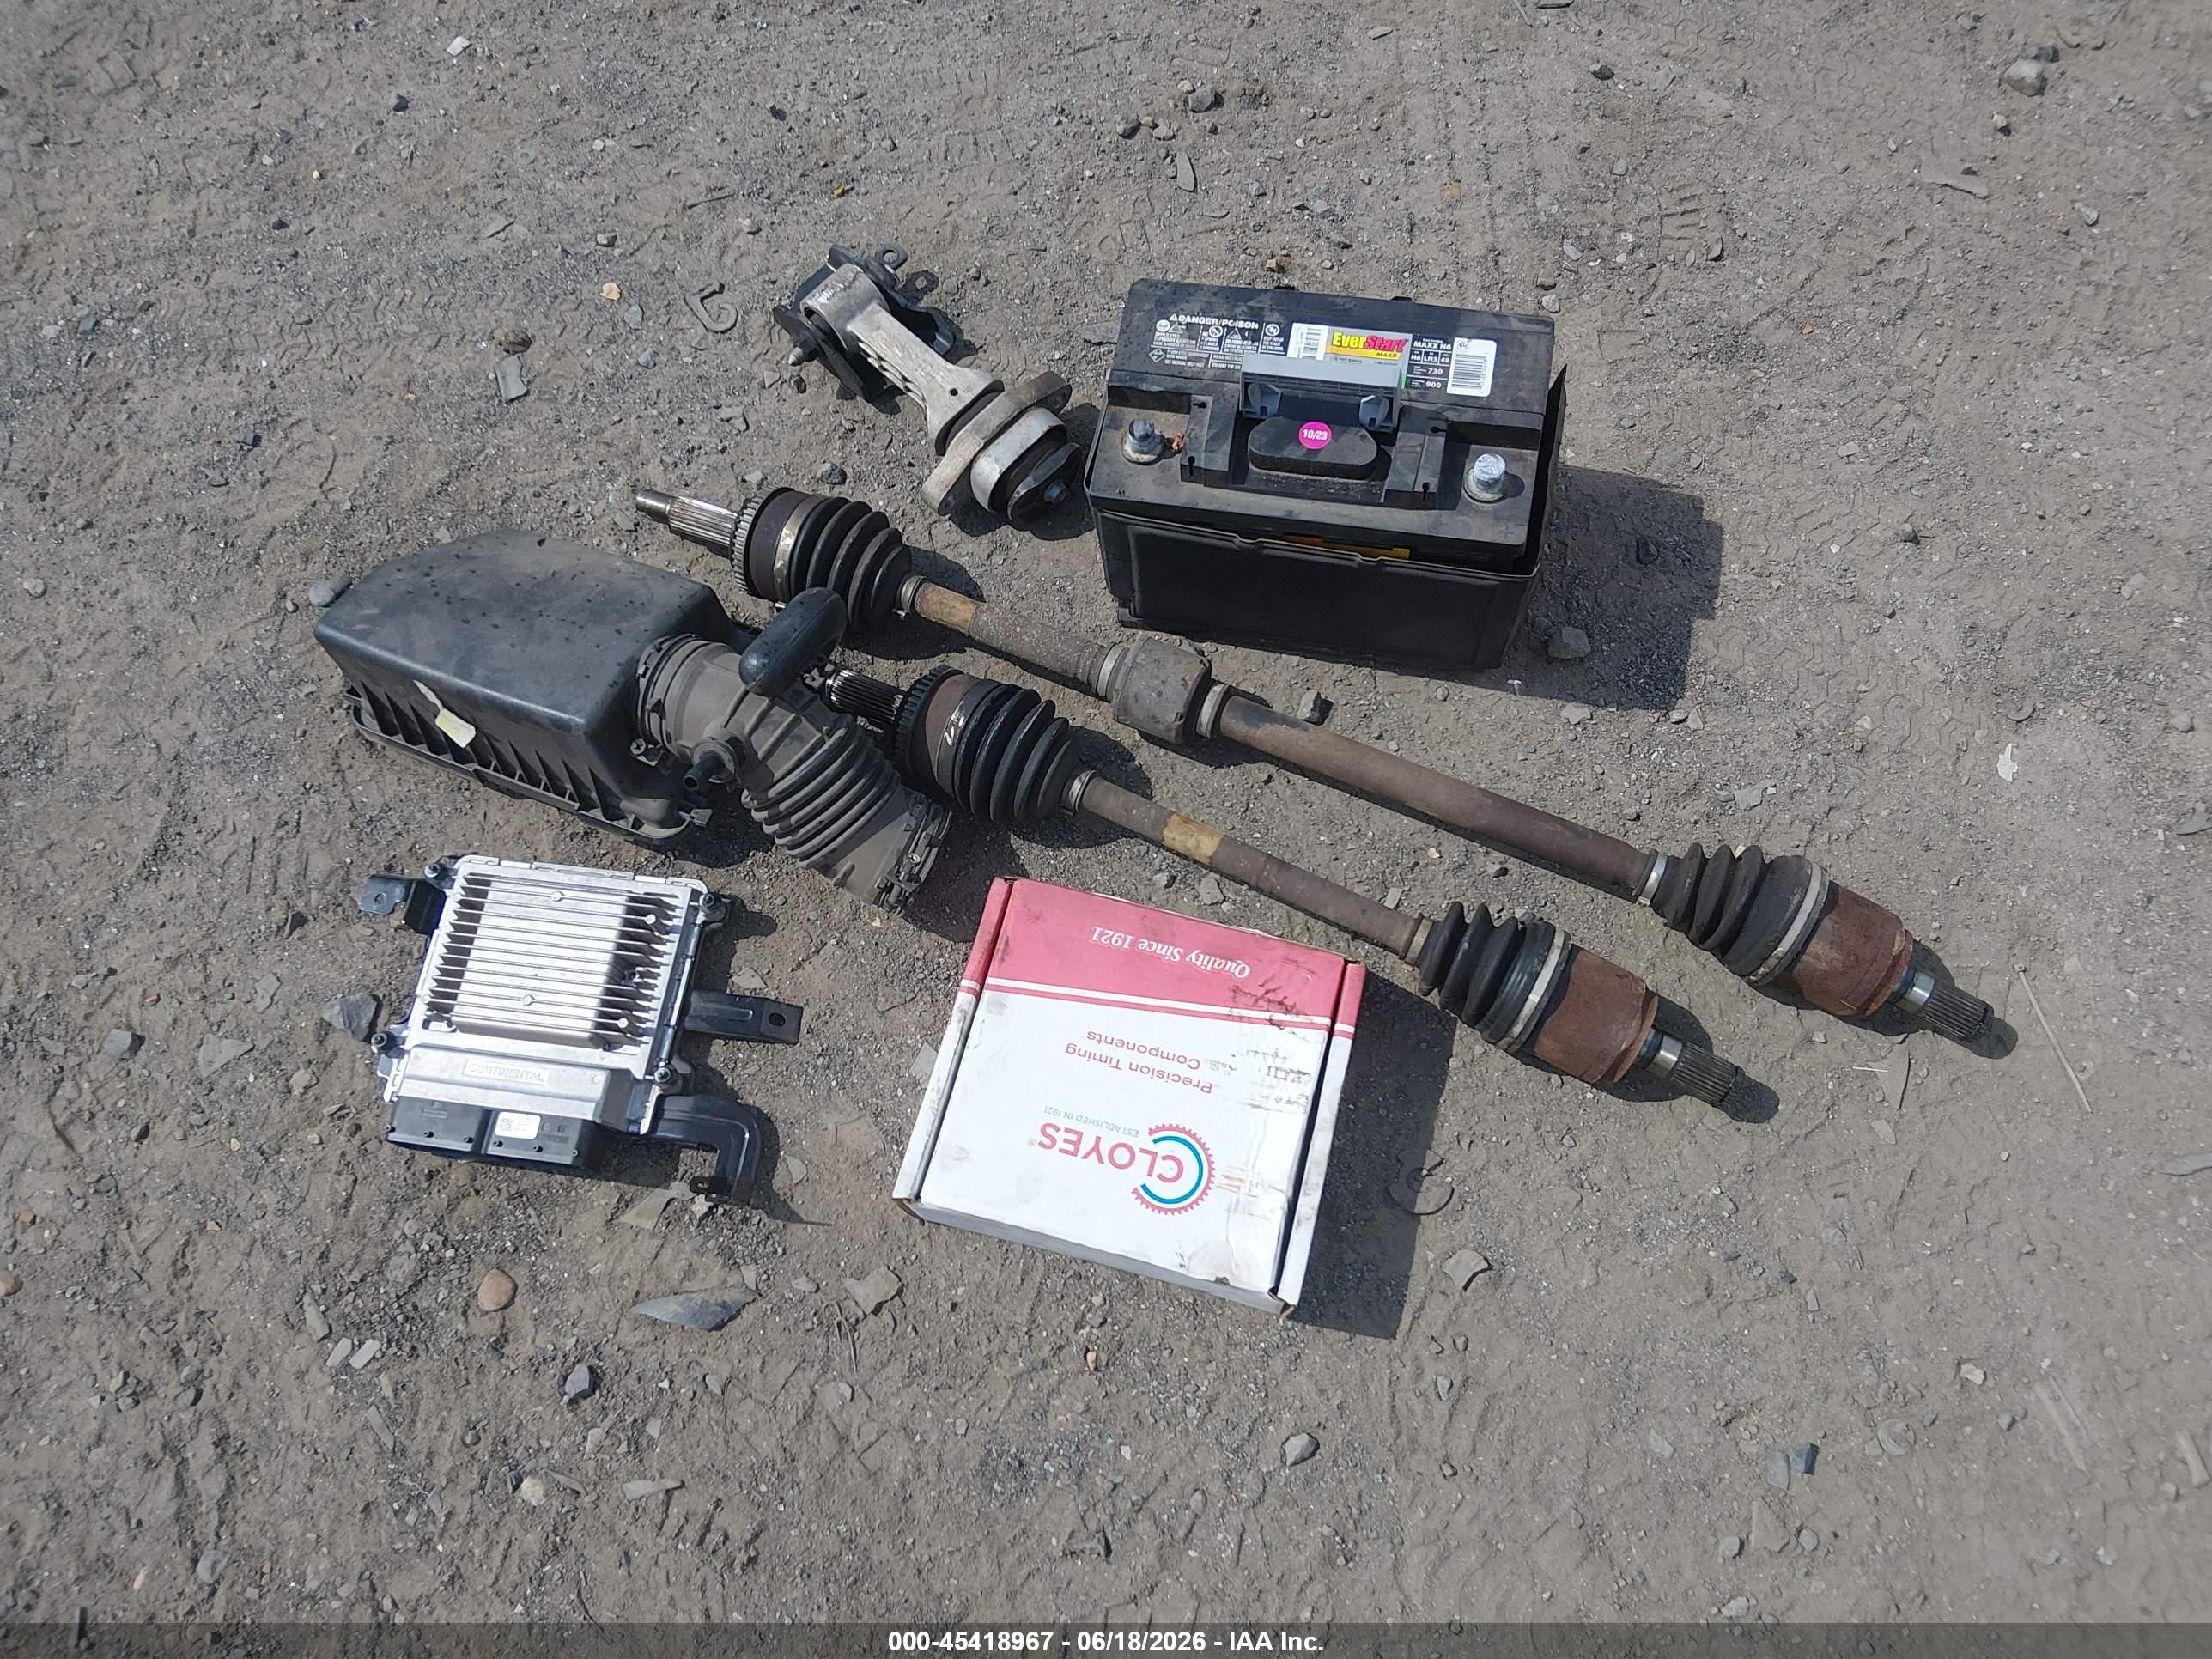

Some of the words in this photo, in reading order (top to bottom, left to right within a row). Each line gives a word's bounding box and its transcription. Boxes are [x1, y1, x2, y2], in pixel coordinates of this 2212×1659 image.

[1179, 315, 1258, 329] DANGER/POISON
[1332, 331, 1406, 352] EverStart
[1413, 340, 1438, 349] MAXX
[1303, 429, 1328, 440] 10/23
[1091, 927, 1134, 949] 1921
[1138, 939, 1183, 962] Since
[1186, 949, 1250, 978] Quality
[1065, 1043, 1122, 1071] Timing
[1086, 1030, 1201, 1070] Components
[470, 1064, 544, 1081] CONTINENTAL
[1128, 1061, 1213, 1094] Precision
[1044, 1106, 1061, 1117] 1921
[1063, 1111, 1074, 1120] IN
[1076, 1114, 1139, 1138] ESTABLISHED
